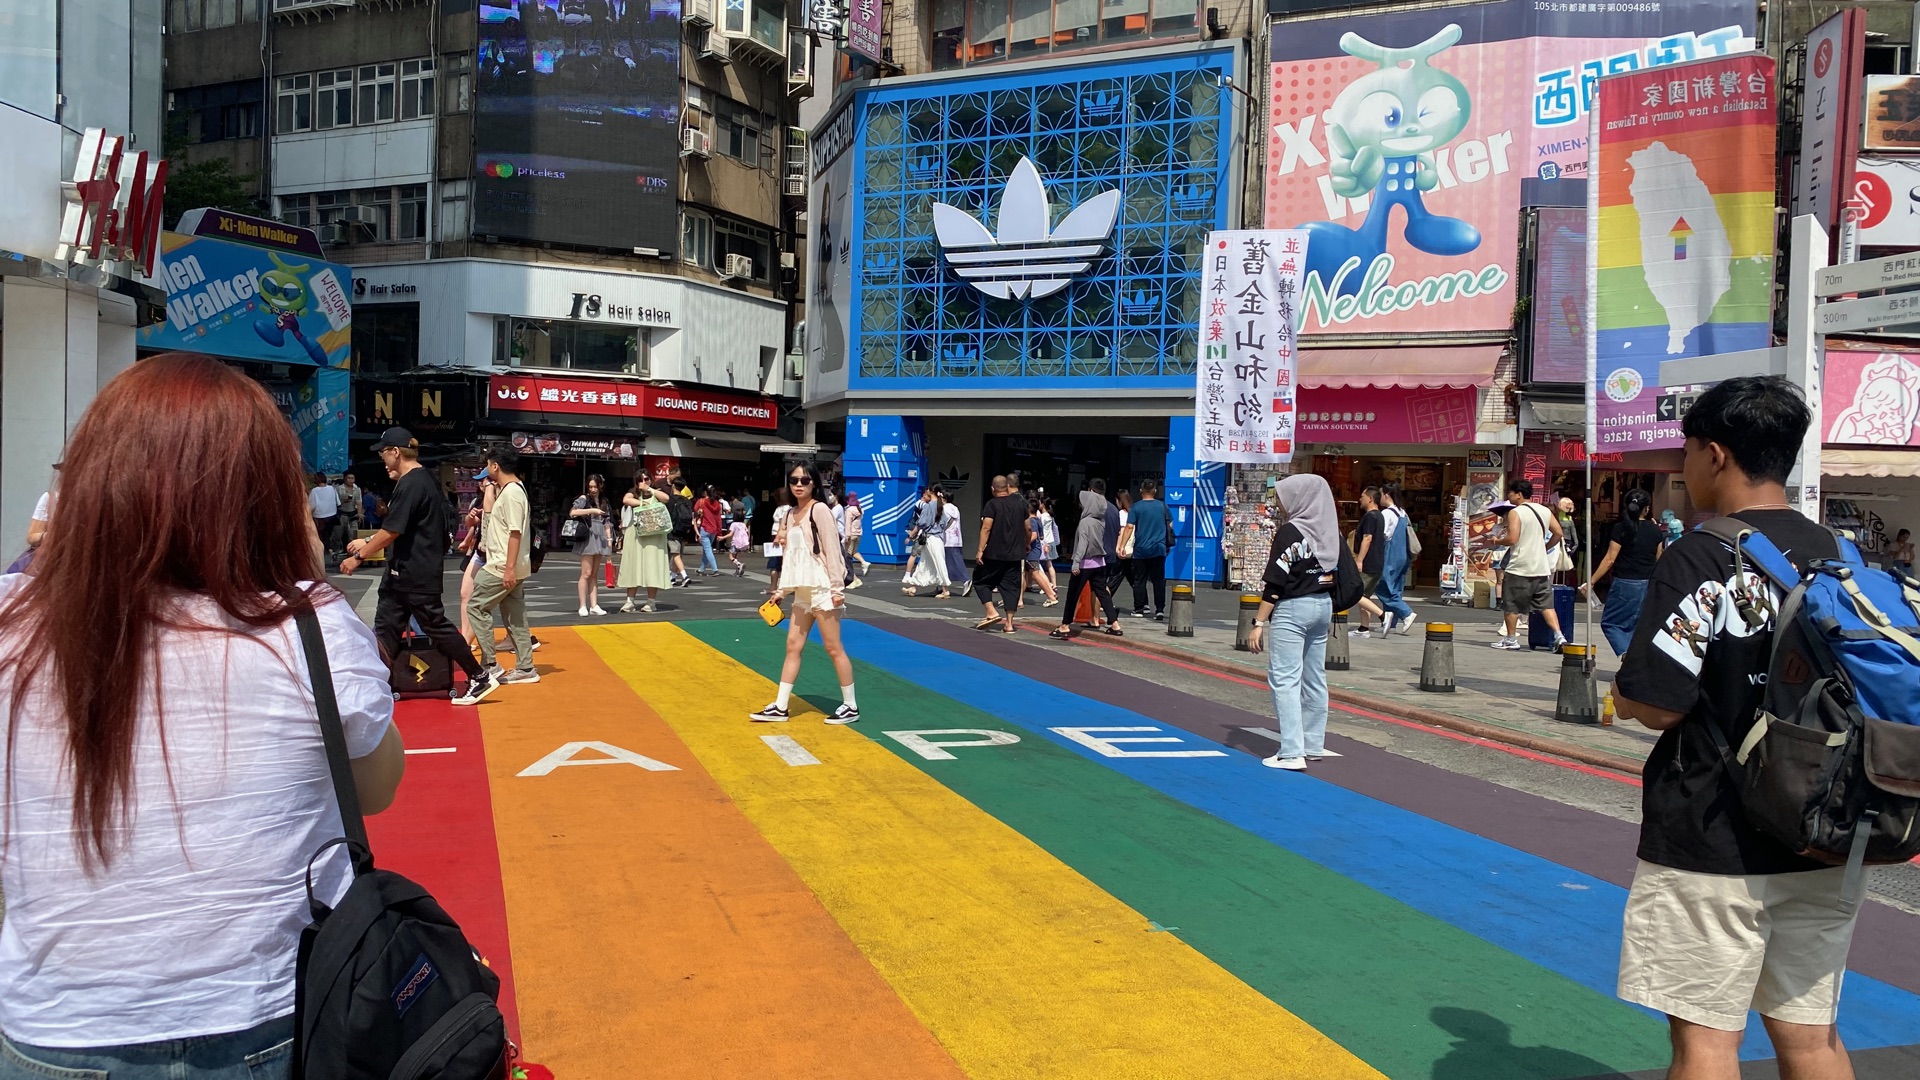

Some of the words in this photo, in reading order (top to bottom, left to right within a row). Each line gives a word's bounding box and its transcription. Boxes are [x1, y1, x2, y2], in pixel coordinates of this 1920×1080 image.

[814, 102, 854, 177] SUPERSTAR
[1538, 136, 1589, 157] XIMEN-
[517, 167, 566, 180] priceless
[646, 176, 668, 188] DBS
[218, 216, 259, 238] Xi-Men
[260, 226, 299, 245] Walker
[1883, 257, 1920, 273] 西門紅
[1824, 275, 1843, 286] 70m
[1881, 275, 1893, 283] The
[1893, 273, 1907, 281] Red
[1907, 269, 1920, 278] Hou
[370, 284, 388, 295] Hair
[390, 283, 416, 294] Salon
[321, 273, 351, 323] WELCOME
[608, 303, 633, 320] Hair
[638, 306, 672, 323] Salon
[1823, 313, 1848, 324] 300m
[498, 385, 529, 399] J&G
[540, 387, 638, 407] 繼光香香雞
[655, 396, 699, 411] JIGUANG
[701, 401, 730, 415] FRIED
[731, 405, 771, 419] CHICKEN
[571, 440, 598, 448] TAIWAN
